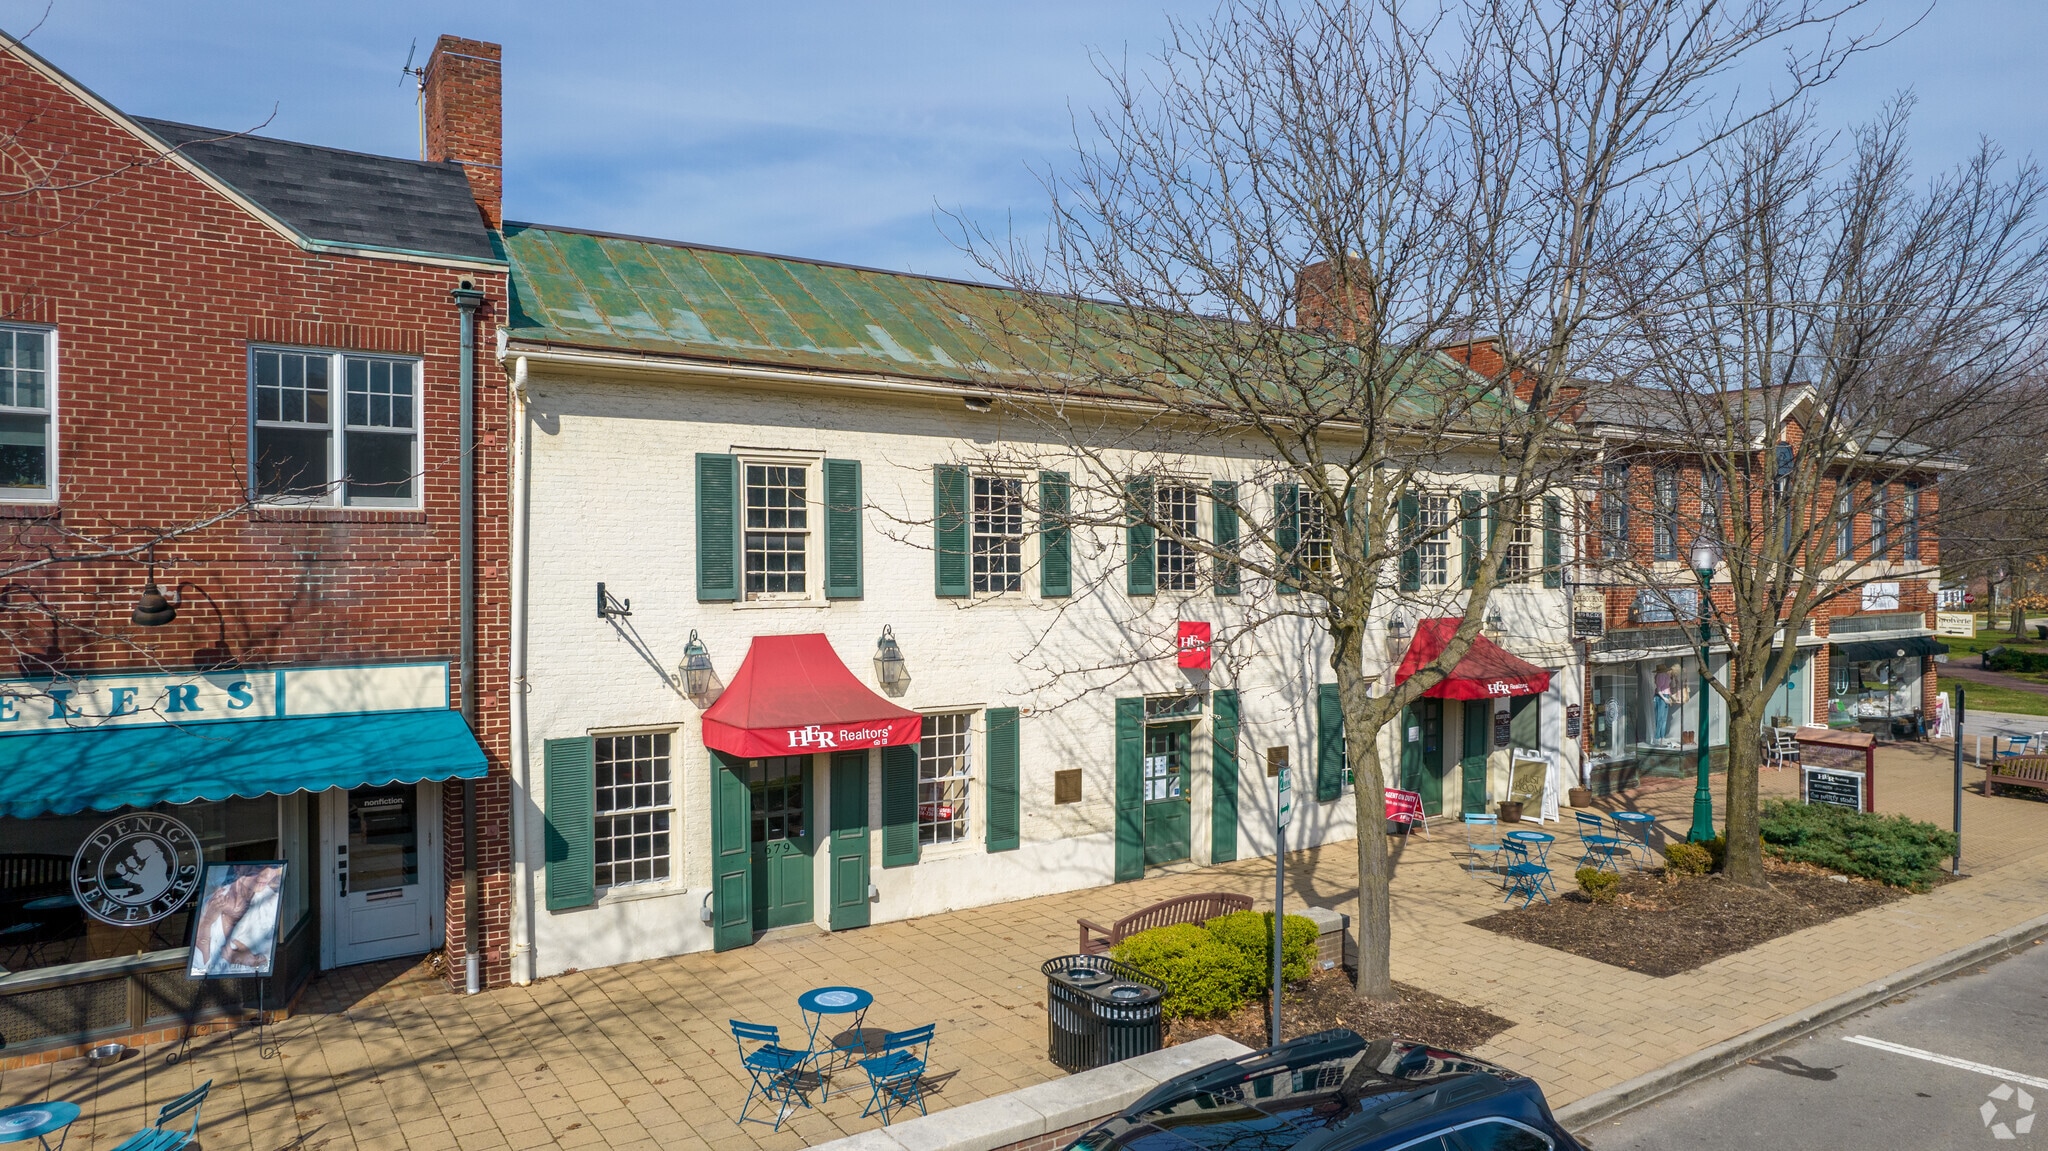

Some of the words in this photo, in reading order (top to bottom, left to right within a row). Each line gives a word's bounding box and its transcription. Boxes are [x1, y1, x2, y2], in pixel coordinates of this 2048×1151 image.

[1180, 635, 1206, 652] HER
[1487, 680, 1511, 694] HER
[787, 725, 838, 748] HER
[1520, 774, 1540, 784] JUST
[1385, 791, 1399, 799] AGENT
[92, 818, 185, 850] DENIG
[764, 843, 790, 854] 679
[78, 865, 196, 920] JEWELERS
